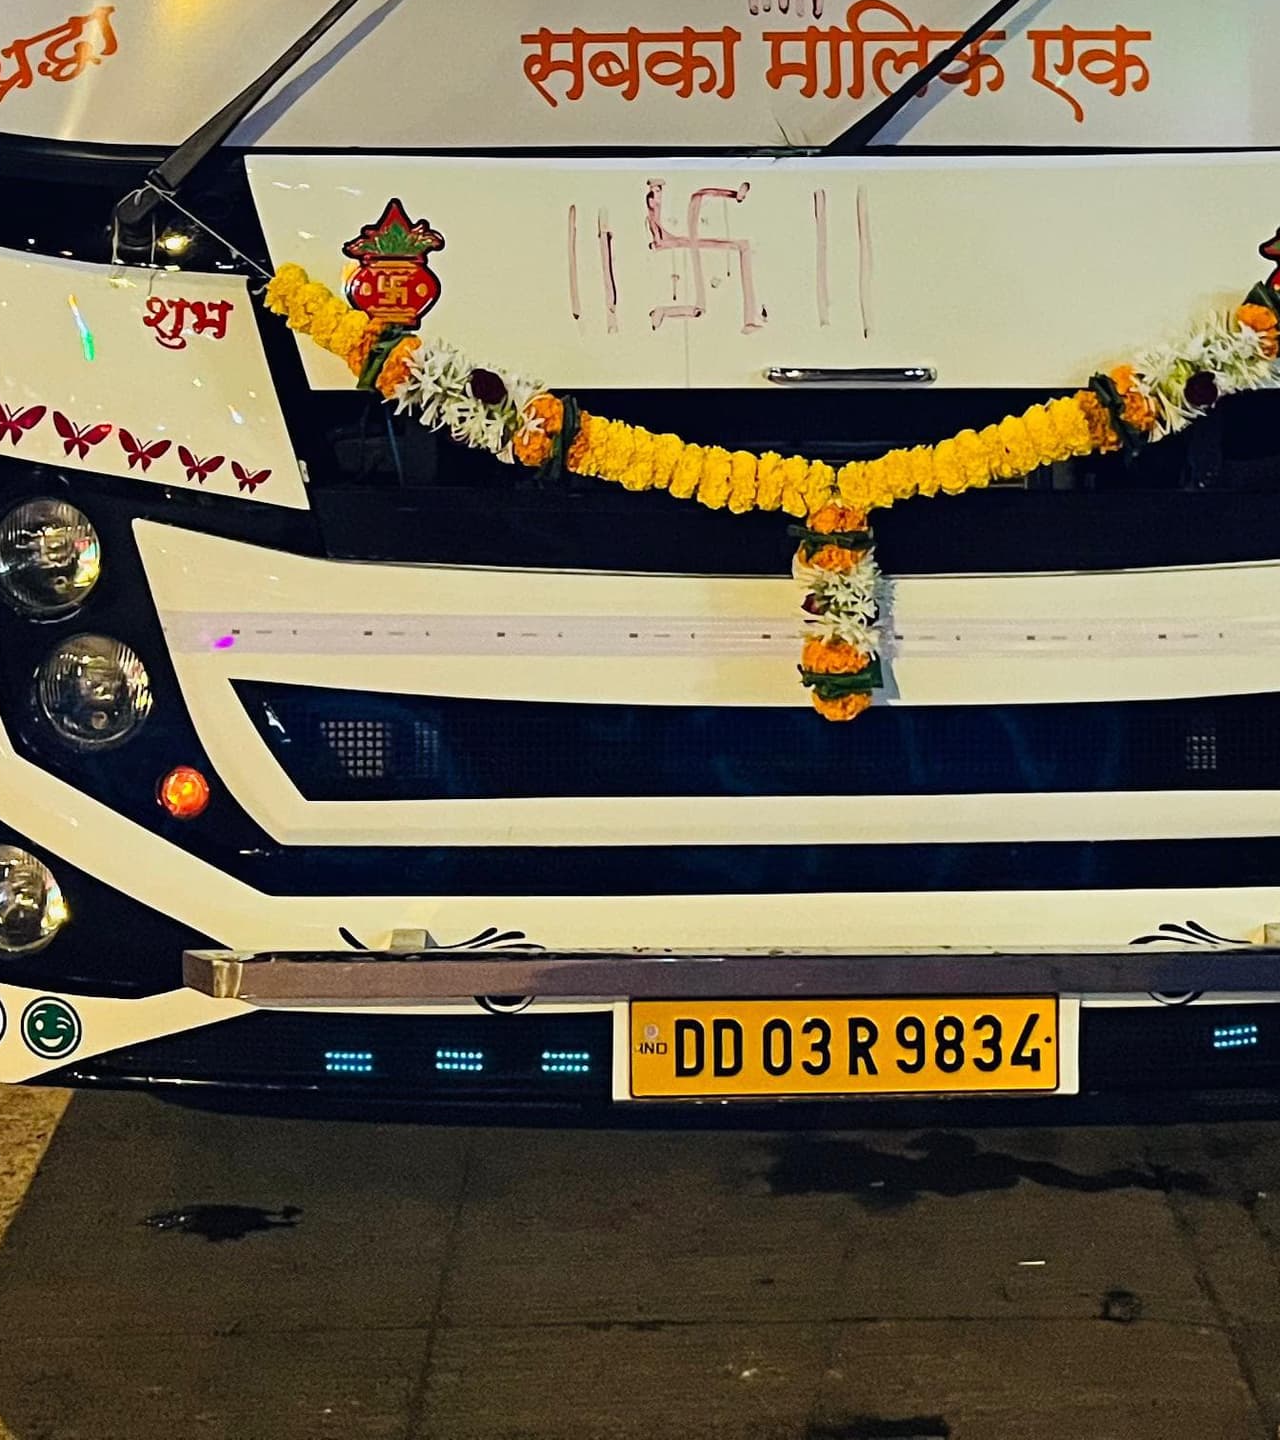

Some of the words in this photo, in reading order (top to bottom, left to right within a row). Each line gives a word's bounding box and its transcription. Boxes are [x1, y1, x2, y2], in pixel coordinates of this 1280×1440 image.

[520, 25, 742, 108] सबका
[1027, 24, 1152, 123] एक
[142, 297, 234, 350] शुभ
[674, 1018, 744, 1078] DD
[762, 1017, 832, 1077] 03
[848, 1017, 879, 1077] R
[895, 1013, 1042, 1076] 9834
